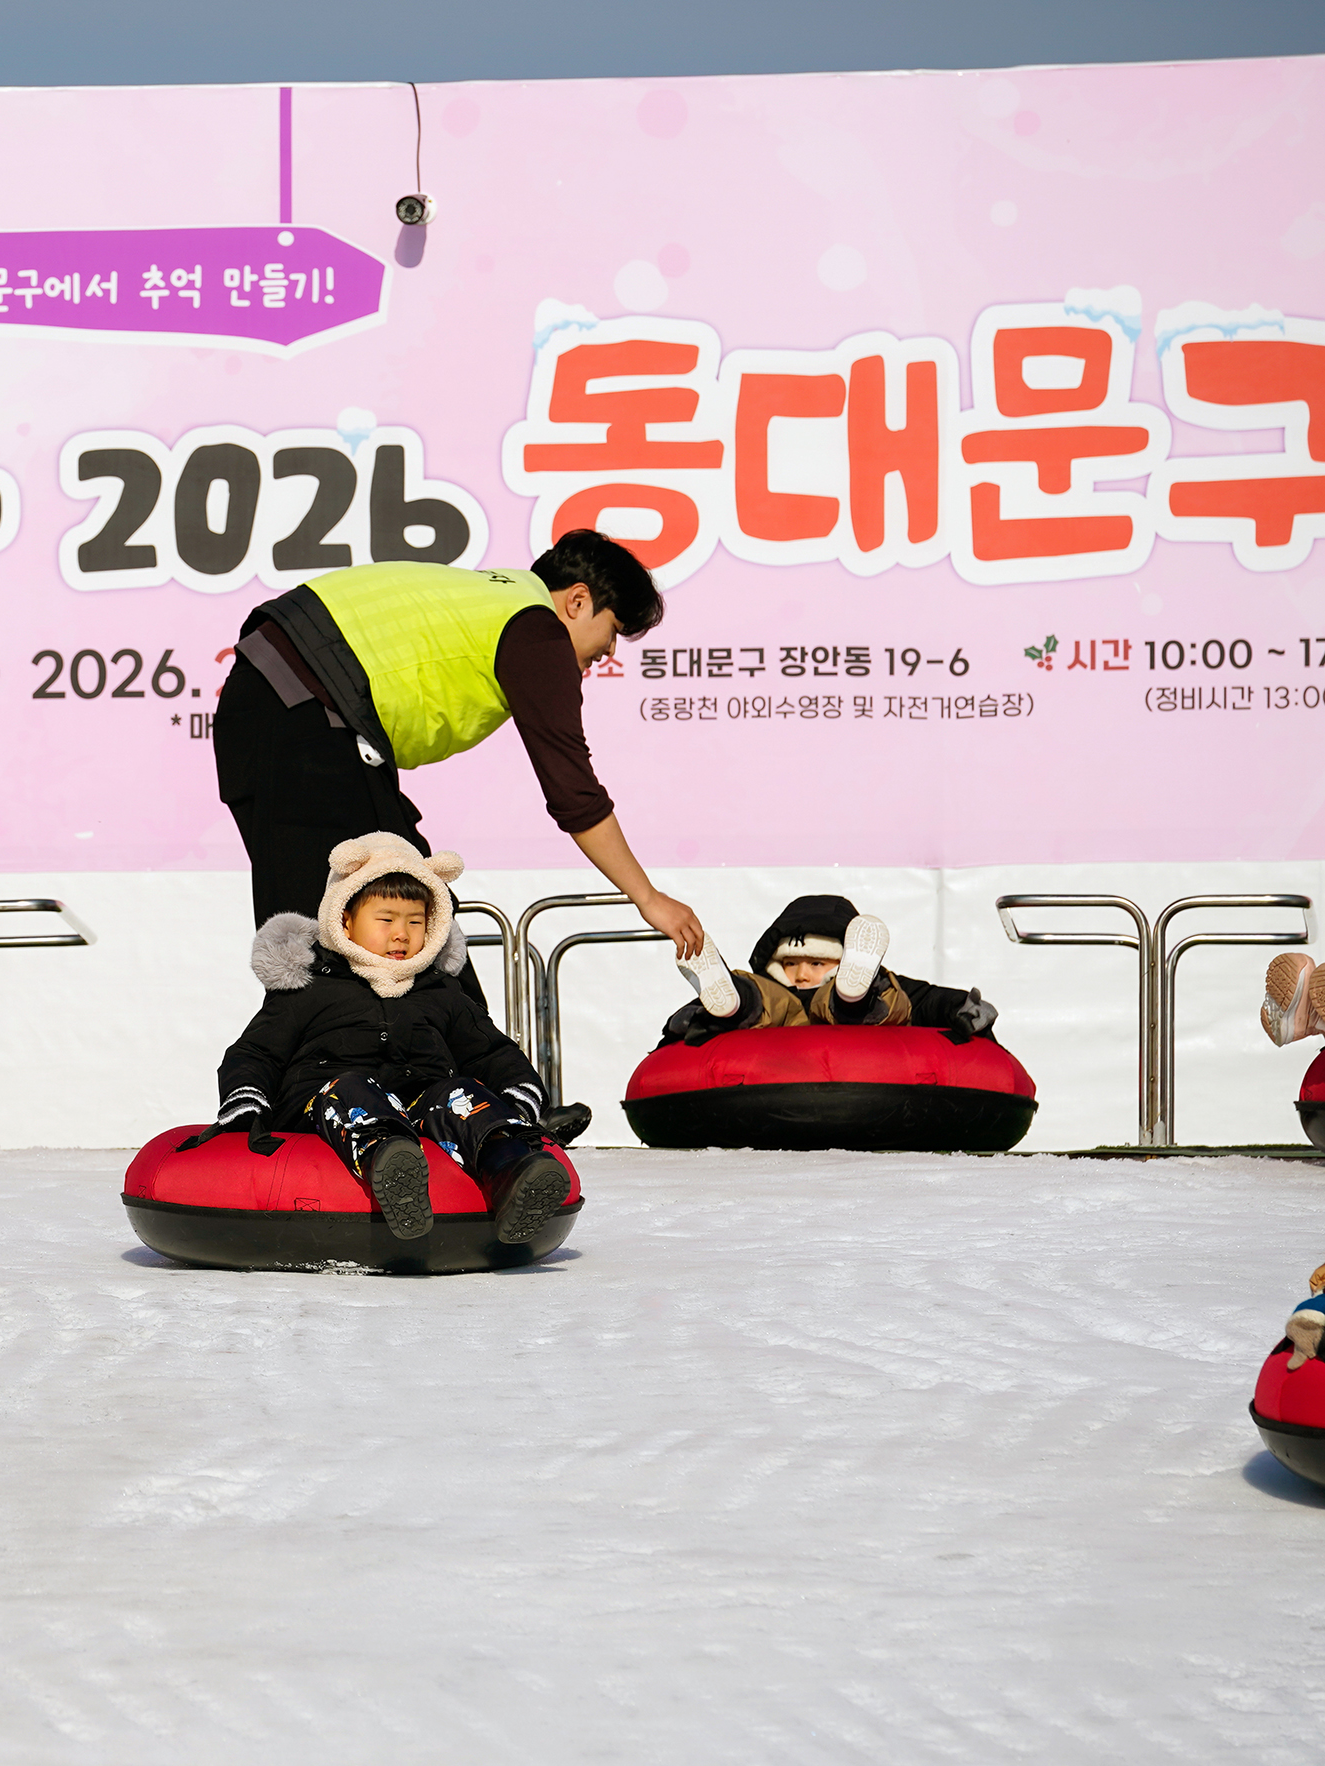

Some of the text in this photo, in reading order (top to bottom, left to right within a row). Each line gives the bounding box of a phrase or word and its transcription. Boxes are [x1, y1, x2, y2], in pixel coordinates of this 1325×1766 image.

[139, 264, 202, 310] 추억
[223, 263, 335, 308] 만들기!
[76, 442, 471, 574] 2026
[523, 326, 1325, 568] 동대문구
[582, 646, 970, 679] 소 동대문구 장안동 19-6
[1067, 638, 1133, 671] 시간
[1144, 638, 1254, 671] 10:00
[640, 692, 1035, 722] (중랑천 야외수영장 및 자전거연습장)
[1144, 685, 1325, 713] (정비시간 13:0
